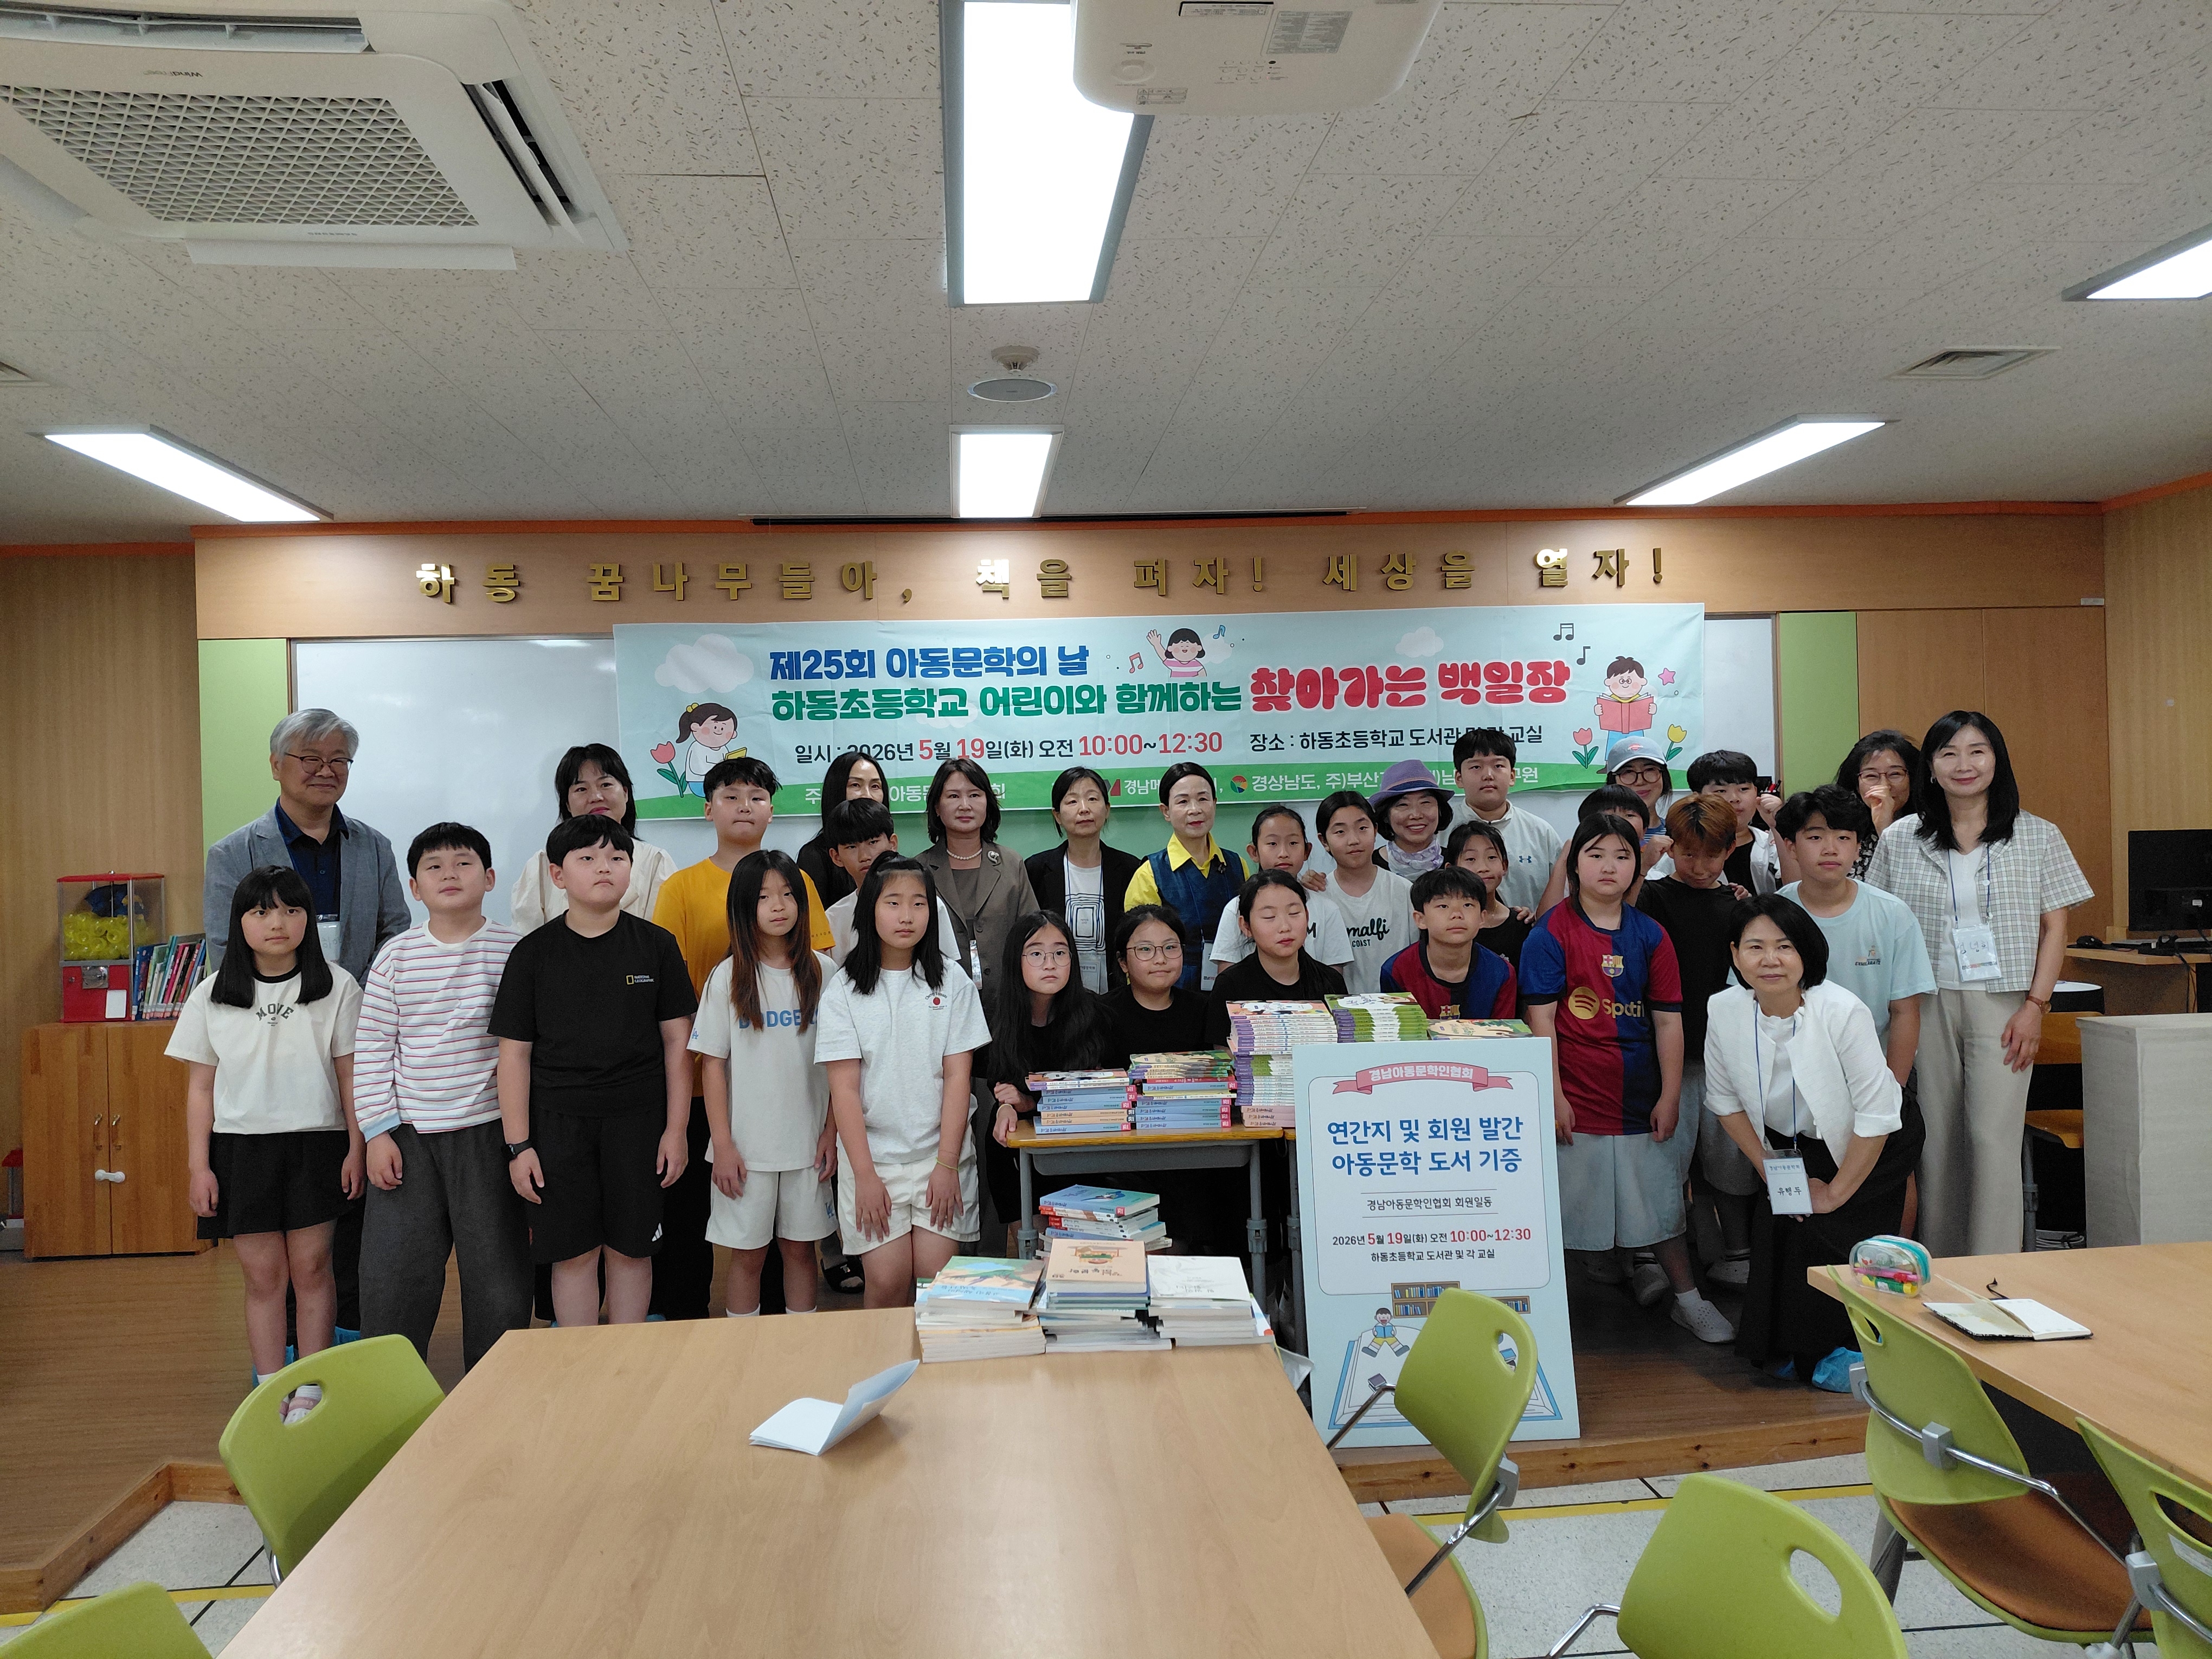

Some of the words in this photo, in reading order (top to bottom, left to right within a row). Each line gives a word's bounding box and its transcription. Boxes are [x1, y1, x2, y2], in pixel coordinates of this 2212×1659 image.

[416, 563, 518, 603] 하동
[588, 561, 912, 603] 꿈나무들아,
[975, 558, 1071, 599] 책을
[1134, 557, 1263, 595] 펴자!
[1323, 552, 1475, 591] 세상을
[1535, 548, 1664, 587] 열자!
[770, 648, 875, 681] 제25회
[885, 646, 1046, 679] 아동문학의
[1057, 645, 1088, 676] 날
[772, 687, 968, 721] 하동초등학교
[979, 684, 1106, 717] 어린이와
[1115, 681, 1242, 714] 함께하는
[1250, 666, 1426, 712] 찾아가는
[1437, 660, 1572, 705] 백일장
[795, 744, 831, 763] 일시
[919, 739, 951, 761] 5월
[956, 737, 1033, 760] 19일(화)
[1039, 739, 1073, 758] 오전
[1079, 731, 1223, 756] 10:00~12:30
[1250, 733, 1285, 751] 장소
[1300, 729, 1405, 750] 하동초등학교
[1409, 727, 1461, 747] 도서관
[1509, 725, 1542, 743] 교실
[1252, 775, 1320, 793] 경상남도,
[1326, 772, 1383, 789] 주)부산
[1347, 917, 1390, 940] malfi
[255, 1003, 294, 1021] MOVE
[739, 1008, 818, 1029] DDGE
[1602, 998, 1645, 1019] Spoti
[1369, 1064, 1474, 1082] 경남아동문학인협회
[1327, 1120, 1392, 1145] 연간지
[1399, 1119, 1420, 1143] 및
[1427, 1117, 1471, 1142] 회원
[1478, 1116, 1523, 1141] 발간
[1332, 1151, 1422, 1177] 아동문학
[1429, 1150, 1471, 1173] 도서
[1478, 1148, 1522, 1173] 기증
[1367, 1197, 1452, 1211] 경남아동문학인협회
[1455, 1196, 1493, 1208] 회원일동
[1332, 1234, 1366, 1247] 2026년
[1367, 1232, 1385, 1246] 5월
[1386, 1231, 1428, 1245] 19일(화)
[1430, 1232, 1448, 1244] 오전
[1450, 1228, 1532, 1243] 10:00~12:30
[1371, 1250, 1425, 1263] 하동초등학교
[1426, 1250, 1454, 1261] 도서관
[1455, 1250, 1465, 1261] 및
[1466, 1249, 1476, 1260] 각
[1477, 1248, 1496, 1259] 교실
